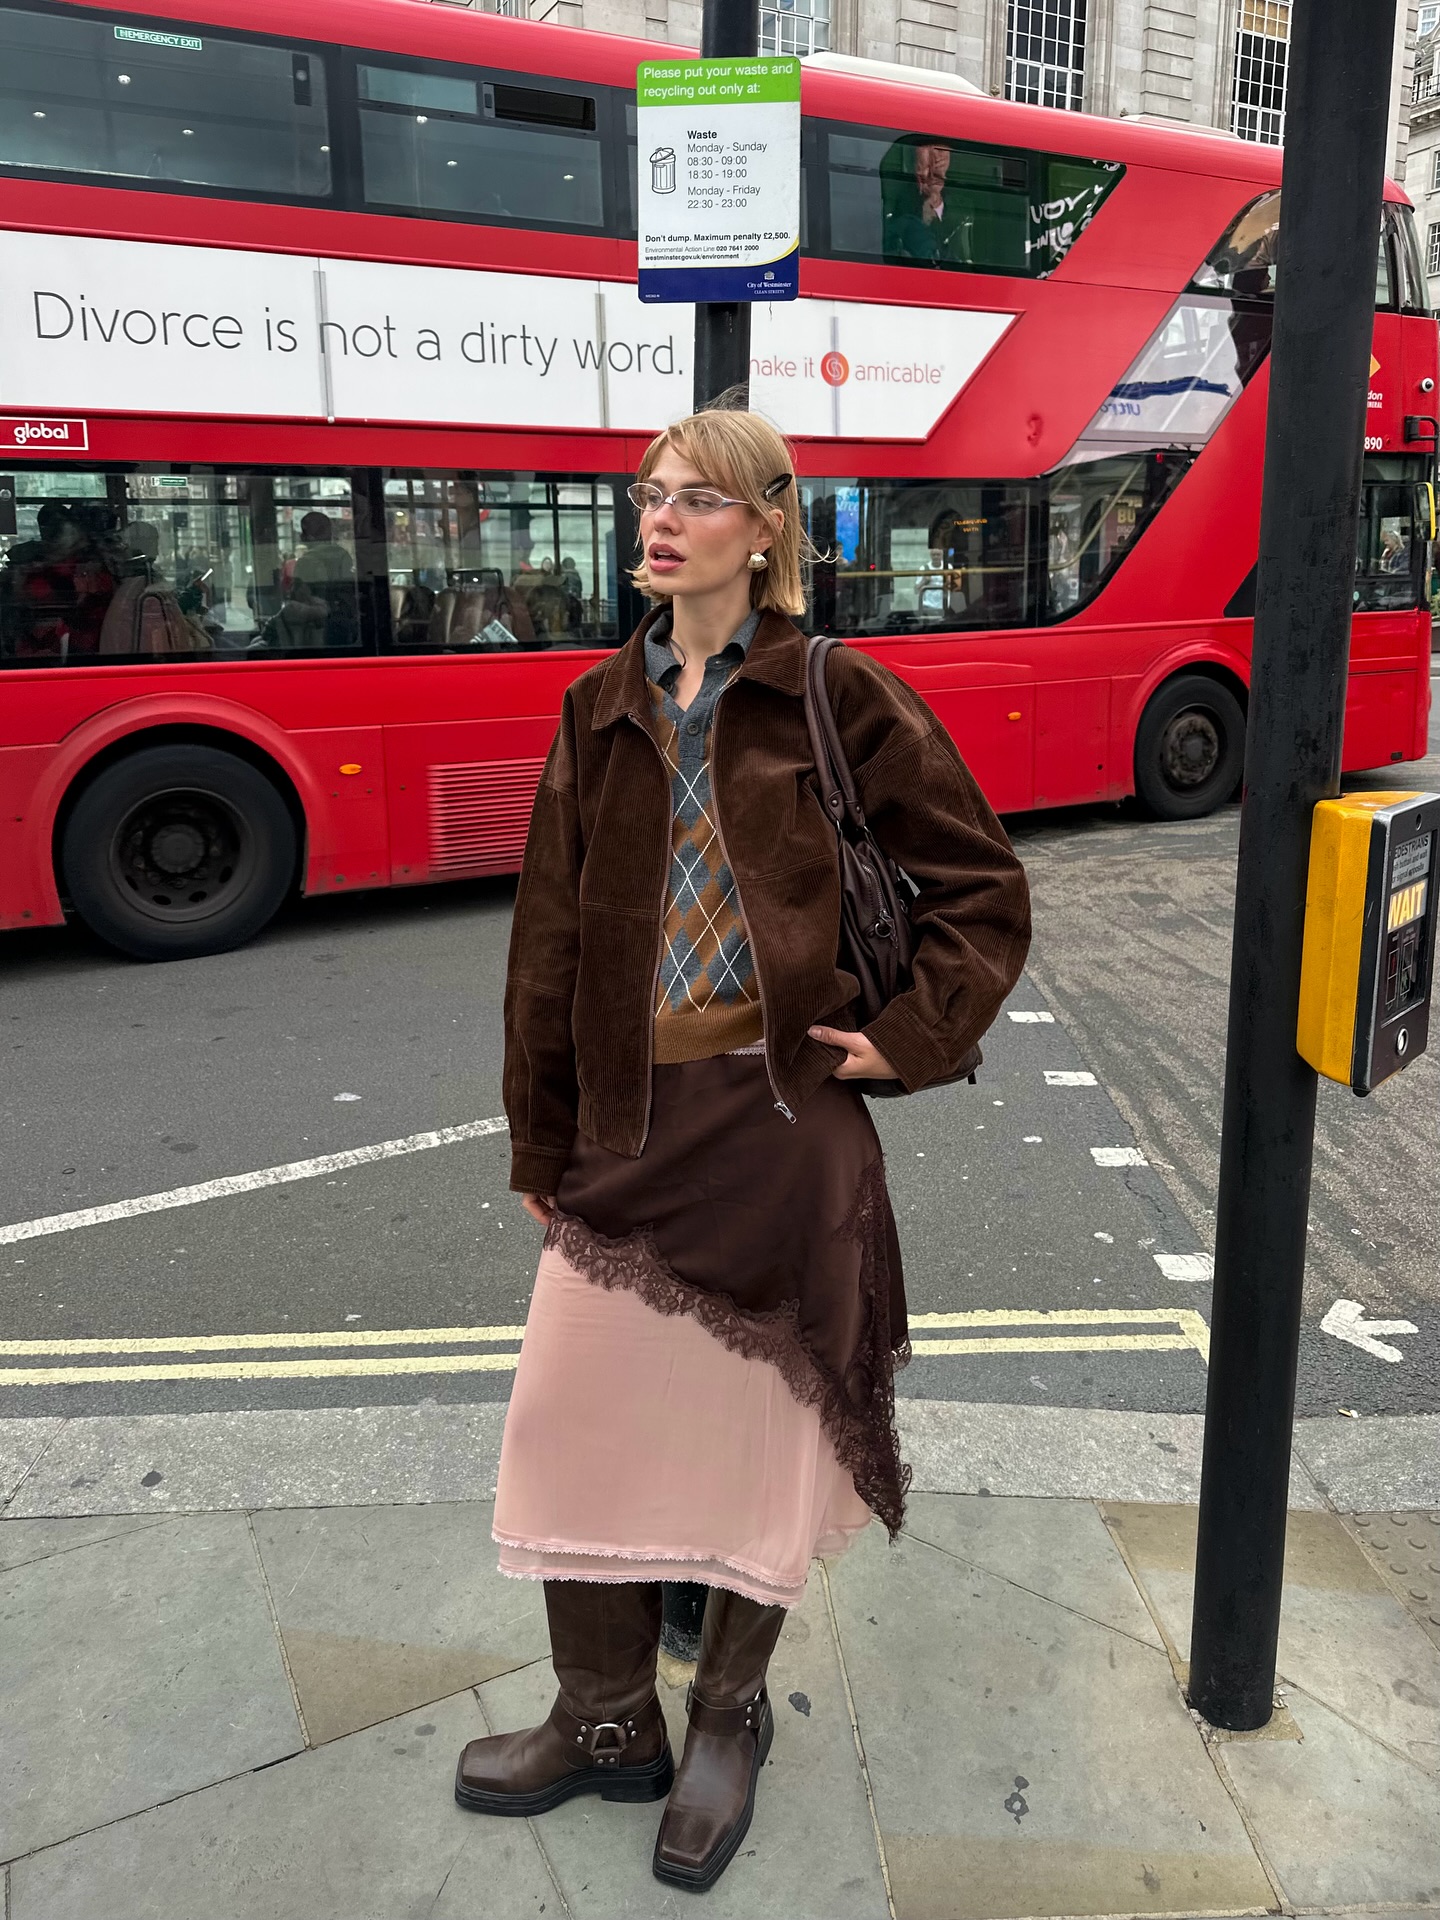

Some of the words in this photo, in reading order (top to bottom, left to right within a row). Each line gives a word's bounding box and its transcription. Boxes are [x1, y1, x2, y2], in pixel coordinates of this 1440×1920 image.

[180, 38, 200, 48] EXIT
[643, 67, 681, 79] Please
[684, 66, 703, 80] put
[706, 66, 732, 79] your
[735, 64, 768, 76] waste
[771, 63, 793, 75] and
[643, 84, 694, 99] recycling
[697, 84, 716, 96] out
[719, 83, 744, 96] only
[746, 83, 761, 94] at:
[686, 130, 718, 140] Waste
[687, 142, 724, 154] Monday
[732, 141, 768, 153] Sunday
[687, 156, 713, 167] 08:30
[721, 155, 747, 166] 09:00
[688, 169, 713, 180] 18:30
[722, 168, 747, 178] 19:00
[687, 186, 724, 198] Monday
[732, 184, 761, 197] Friday
[687, 199, 713, 209] 22:30
[721, 198, 747, 208] 23:00
[645, 234, 666, 243] Don't
[667, 234, 692, 244] dump.
[693, 233, 731, 242] Maximum
[733, 232, 761, 242] penalty
[763, 231, 791, 241] £2,500.
[746, 281, 757, 290] City
[33, 291, 243, 349] Divorce
[265, 306, 297, 352] is
[319, 315, 398, 358] not
[416, 328, 441, 361] a
[460, 321, 558, 377] dirty
[573, 335, 683, 376] word.
[803, 357, 816, 379] it
[13, 422, 70, 445] global
[1394, 834, 1429, 859] EDESTRIANS
